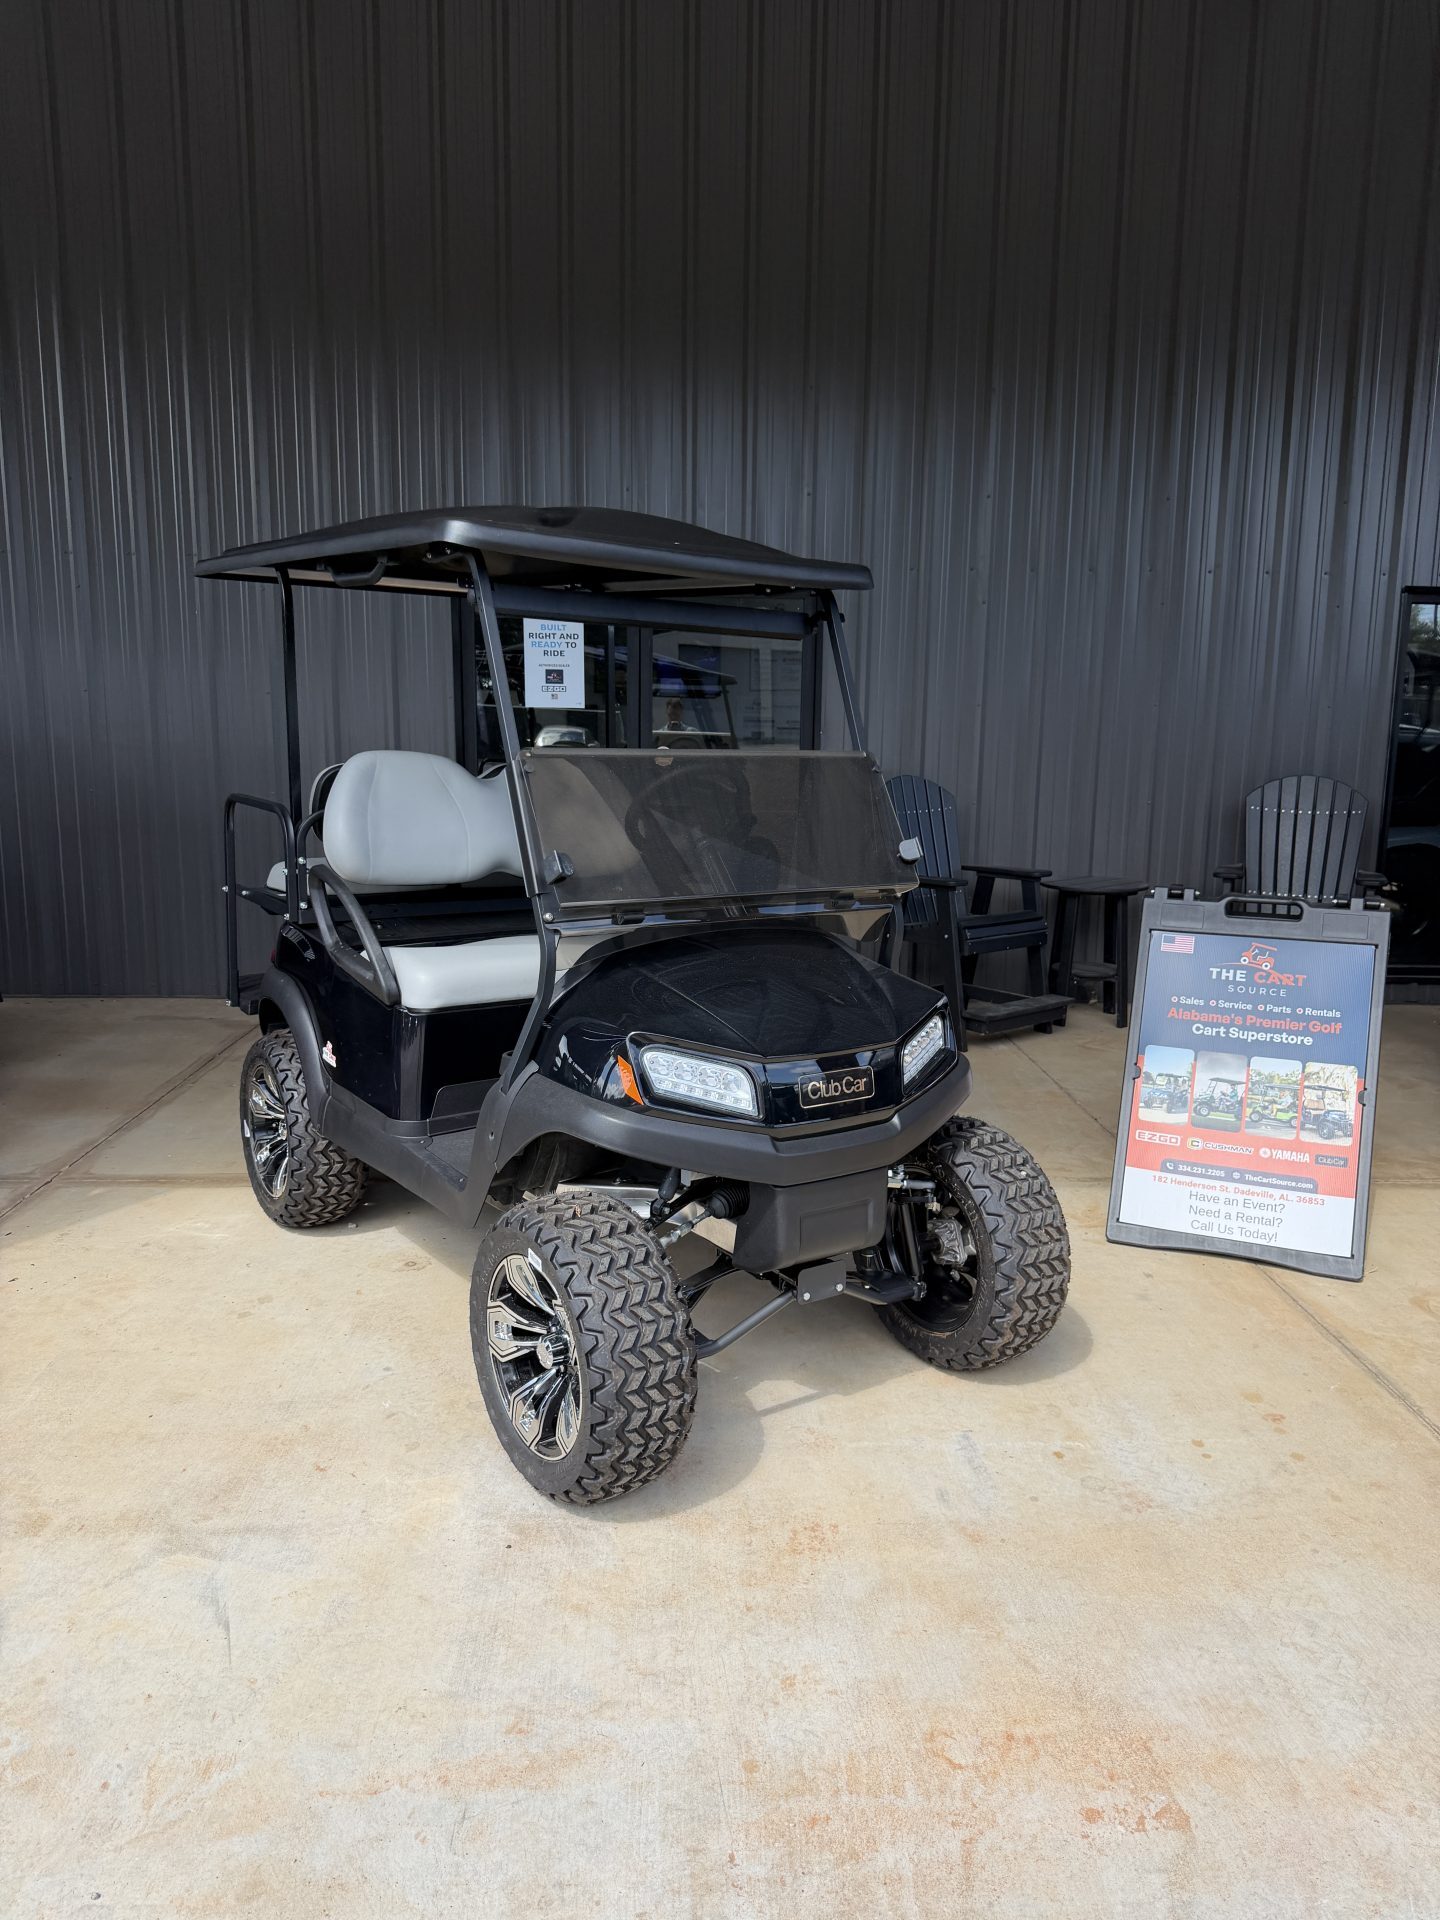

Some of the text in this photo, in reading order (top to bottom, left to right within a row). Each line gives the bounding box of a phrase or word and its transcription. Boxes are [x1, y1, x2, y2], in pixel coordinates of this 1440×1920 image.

[1209, 967, 1307, 987] THE CART
[1228, 985, 1287, 997] SOURCE
[1179, 996, 1342, 1018] Sales Service Parts Rentals
[1168, 1008, 1343, 1035] Alabama's Premier Golf
[1192, 1023, 1314, 1046] Cart Superstore
[1204, 1141, 1253, 1155] CUSHMAN
[1271, 1148, 1310, 1163] YAMAHA
[1177, 1164, 1226, 1178] 334.231.2205
[1244, 1173, 1314, 1190] TheCartSource.com
[1152, 1175, 1326, 1206] 182 Henderson St. Dadeville, AL. 36853
[1189, 1190, 1286, 1214] Have an Event?
[1188, 1204, 1283, 1228] Need a Rental?
[1190, 1219, 1278, 1244] Call Us Today!
